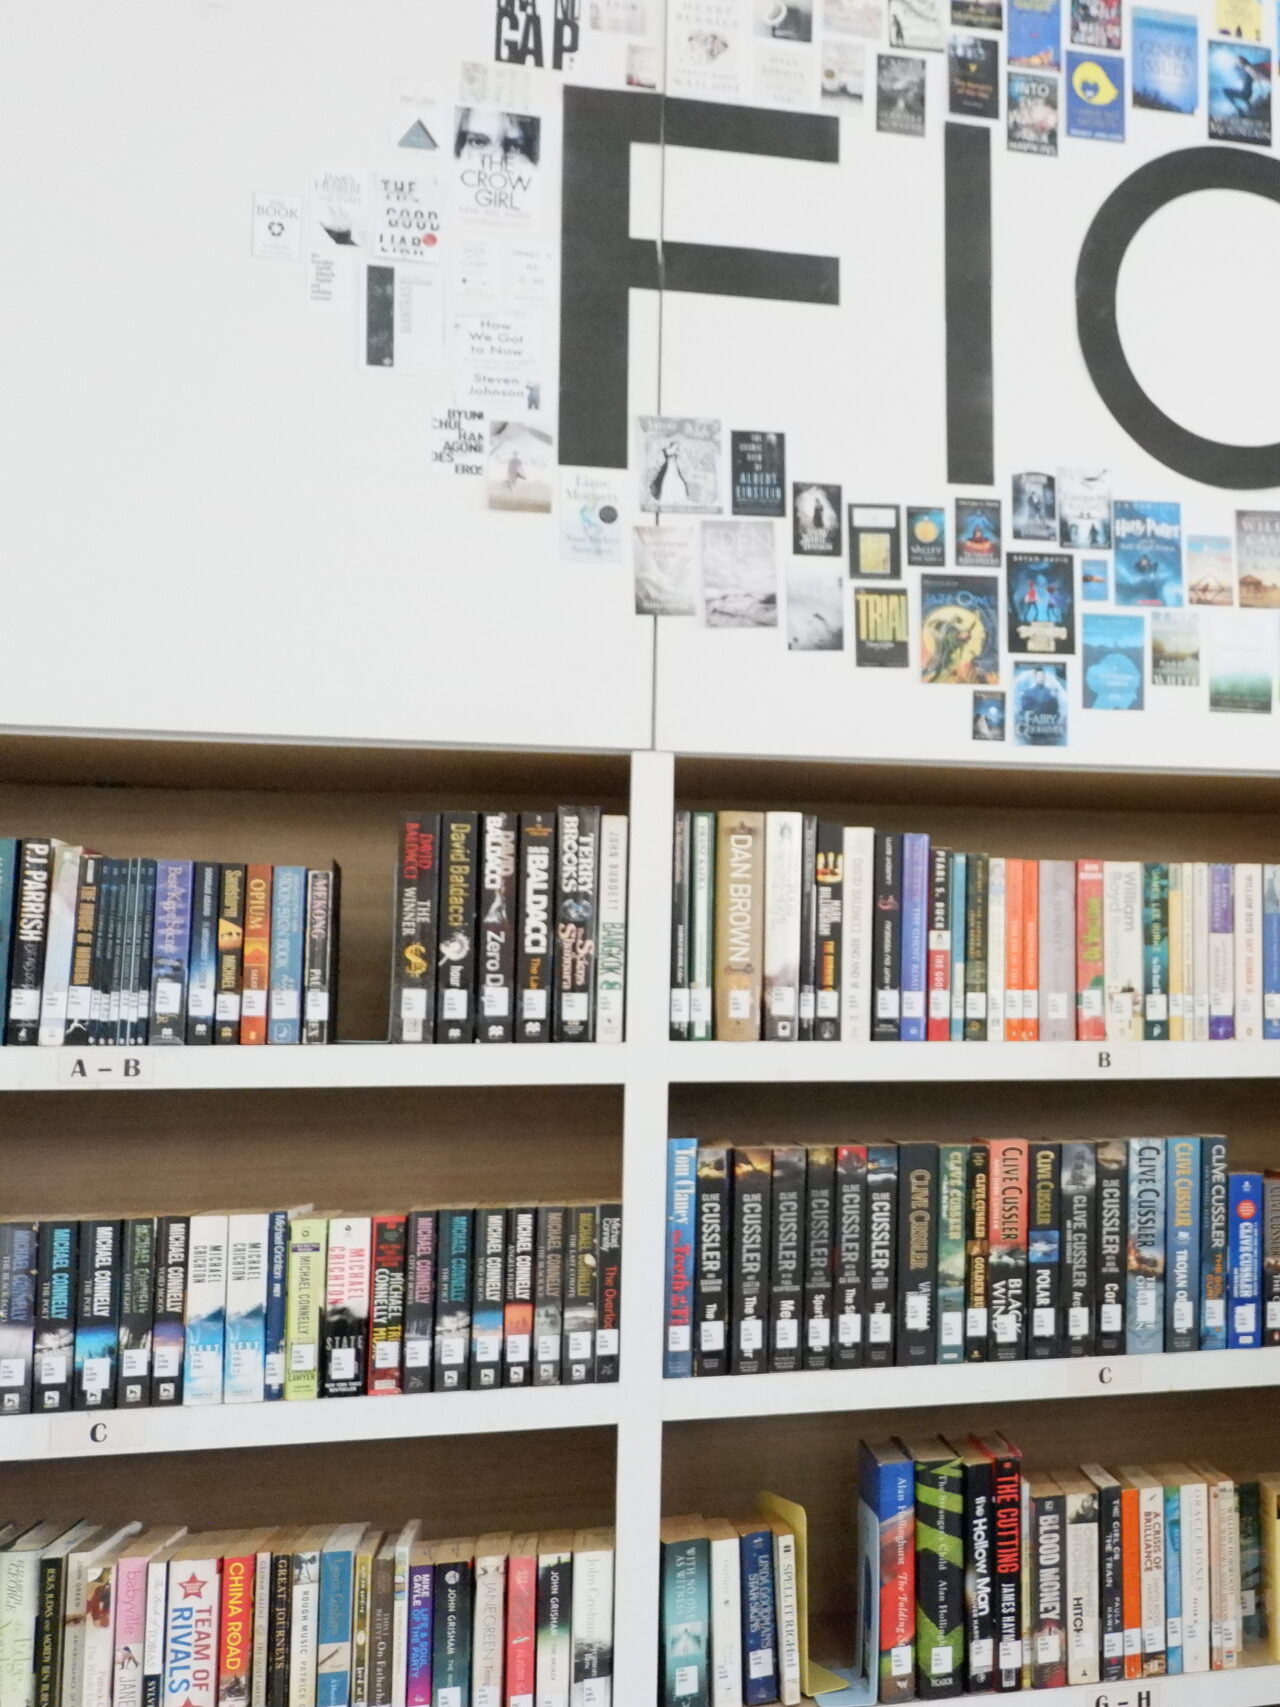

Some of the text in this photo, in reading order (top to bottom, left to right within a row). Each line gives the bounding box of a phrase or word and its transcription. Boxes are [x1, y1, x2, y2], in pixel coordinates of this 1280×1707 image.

[256, 203, 300, 221] BOOK
[460, 169, 533, 193] CROW
[474, 189, 521, 212] GIRL
[468, 331, 493, 343] We
[480, 319, 512, 331] How
[467, 385, 525, 400] Johnson
[472, 373, 520, 386] Steven
[857, 593, 909, 642] TRIAL
[403, 822, 434, 880] DAVID BALDACCI
[448, 822, 472, 927] David Baldacci
[484, 815, 502, 889] BALDACCI
[561, 815, 595, 896] TERRY BROOKS
[19, 871, 48, 942] PARRISH
[249, 878, 266, 930] OPIUM
[311, 876, 328, 940] MEKONG
[402, 887, 432, 937] THE WINNER
[525, 855, 550, 954] BALDACCI
[727, 834, 753, 964] DAN BROWN
[1122, 871, 1137, 932] William
[486, 930, 506, 972] Zero
[70, 1058, 87, 1078] A
[123, 1058, 141, 1078] B
[1098, 1051, 1112, 1069] B
[1000, 1146, 1024, 1241] CLIVE CUSSLER
[1035, 1150, 1056, 1226] CLIVE CUSSLER
[1135, 1145, 1161, 1250] CLIVE CUSSLER
[1173, 1142, 1194, 1228] CLIVE CUSSLER
[1209, 1144, 1227, 1249] CLIVE CUSSLER
[451, 1216, 468, 1254] MICHAEL
[701, 1202, 721, 1273] CUSSLER
[742, 1202, 762, 1273] CUSSLER
[778, 1200, 798, 1271] CUSSLER
[810, 1199, 829, 1269] CUSSLER
[841, 1193, 861, 1264] CUSSLER
[871, 1201, 891, 1270] CUSSLER
[1071, 1195, 1088, 1289] CLIVE CUSSLER
[1101, 1186, 1121, 1255] CUSSLER
[51, 1228, 71, 1320] MICHAEL CONNELLY
[93, 1226, 114, 1317] MICHAEL CONNELLY
[165, 1223, 187, 1313] MICHAEL CONNELLY
[193, 1244, 223, 1284] MICHAEL CRICHTON
[232, 1241, 262, 1281] MICHAEL CRICHTON
[300, 1255, 311, 1291] MICHAEL
[327, 1246, 366, 1306] MICHAEL CRICHTON
[414, 1217, 434, 1304] MICHAEL CONNELLY
[485, 1215, 504, 1302] MICHAEL CONNELLY
[515, 1213, 534, 1300] MICHAEL CONNELLY
[1035, 1269, 1052, 1307] POLAR
[1175, 1249, 1189, 1289] TROJAN
[373, 1267, 404, 1325] MICHAEL CONNELLY
[1098, 1366, 1113, 1384] C
[89, 1422, 108, 1443] C
[995, 1472, 1021, 1575] THE CUTTING
[1142, 1511, 1153, 1573] BRILLIANCE
[973, 1496, 992, 1617] the Hollow Man
[1038, 1513, 1061, 1621] BLOOD MONEY
[123, 1570, 143, 1636] babyville
[225, 1562, 245, 1671] CHINA ROAD
[275, 1559, 288, 1670] GREAT JOURNEYS
[412, 1574, 431, 1607] MIKE GAYLE
[999, 1583, 1016, 1614] JAMES
[169, 1605, 214, 1695] TEAM OF RIVALS
[447, 1615, 457, 1655] GRISHAM
[121, 1676, 137, 1707] JANE
[1137, 1690, 1151, 1707] H
